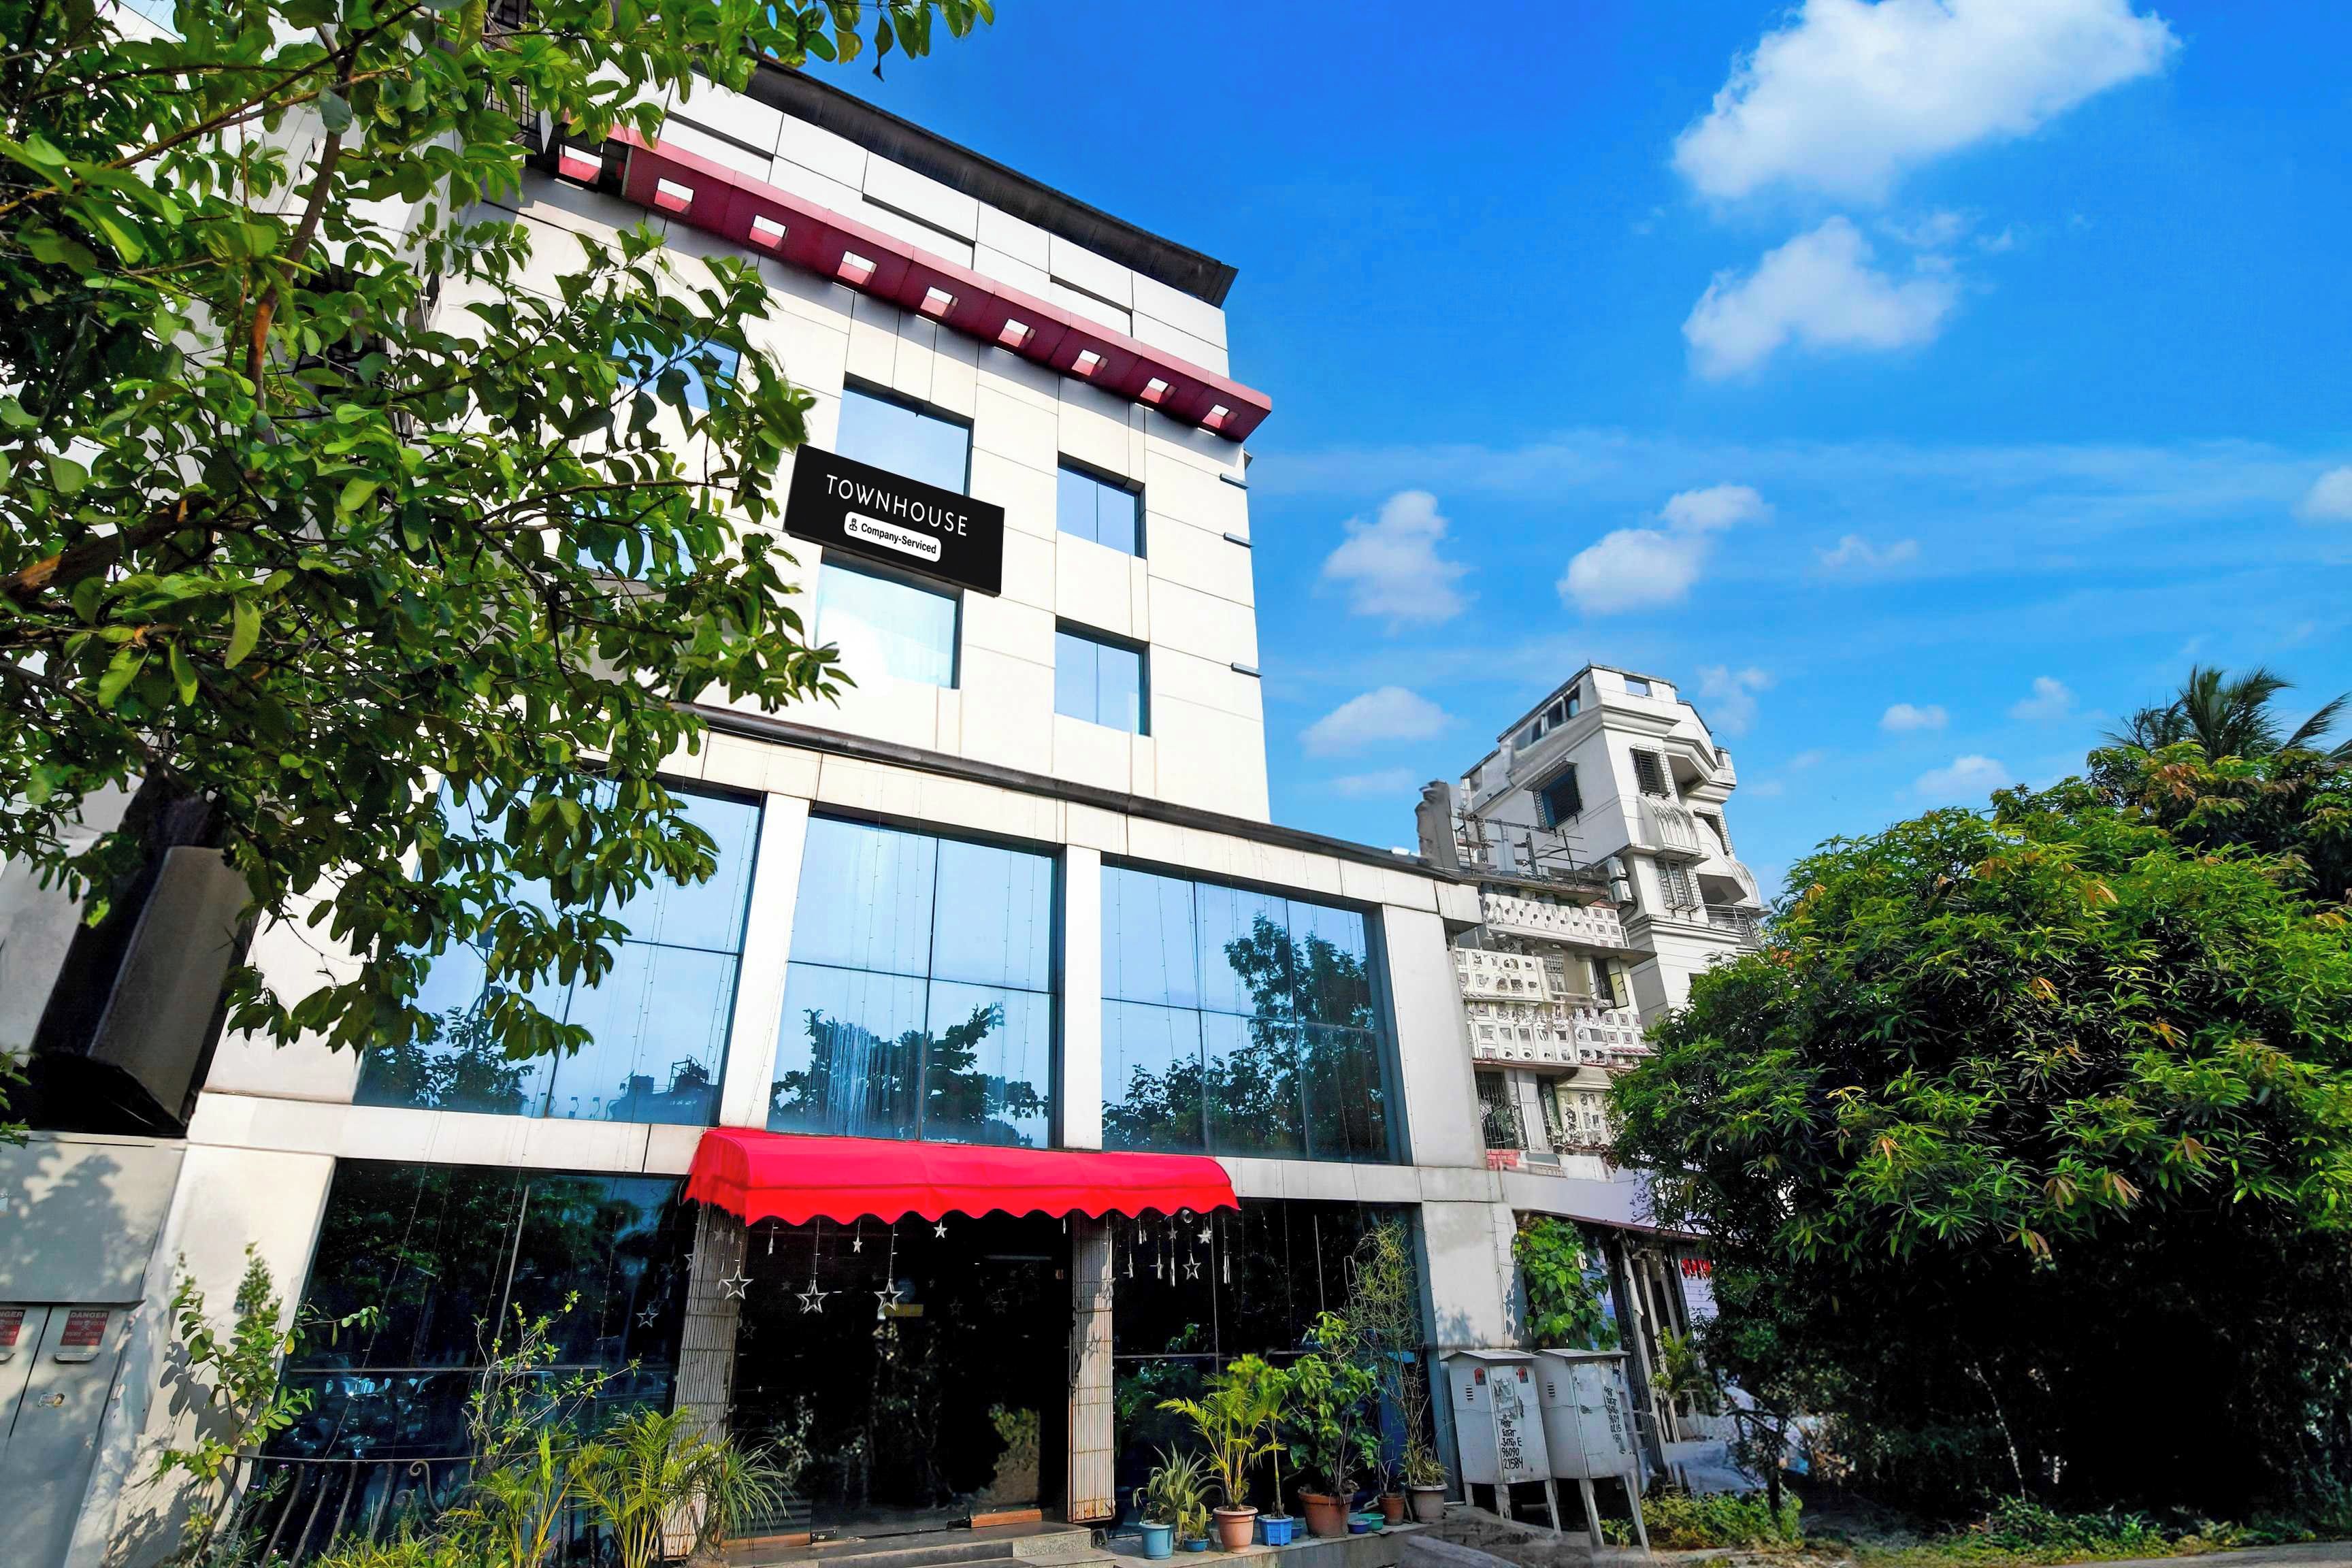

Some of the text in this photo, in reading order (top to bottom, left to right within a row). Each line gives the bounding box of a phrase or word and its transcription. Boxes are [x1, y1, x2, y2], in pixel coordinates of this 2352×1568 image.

[826, 474, 969, 536] TOWNHOUSE
[861, 523, 936, 555] Company-Serviced
[1501, 1447, 1520, 1458] 96090
[1503, 1456, 1524, 1470] 21584
